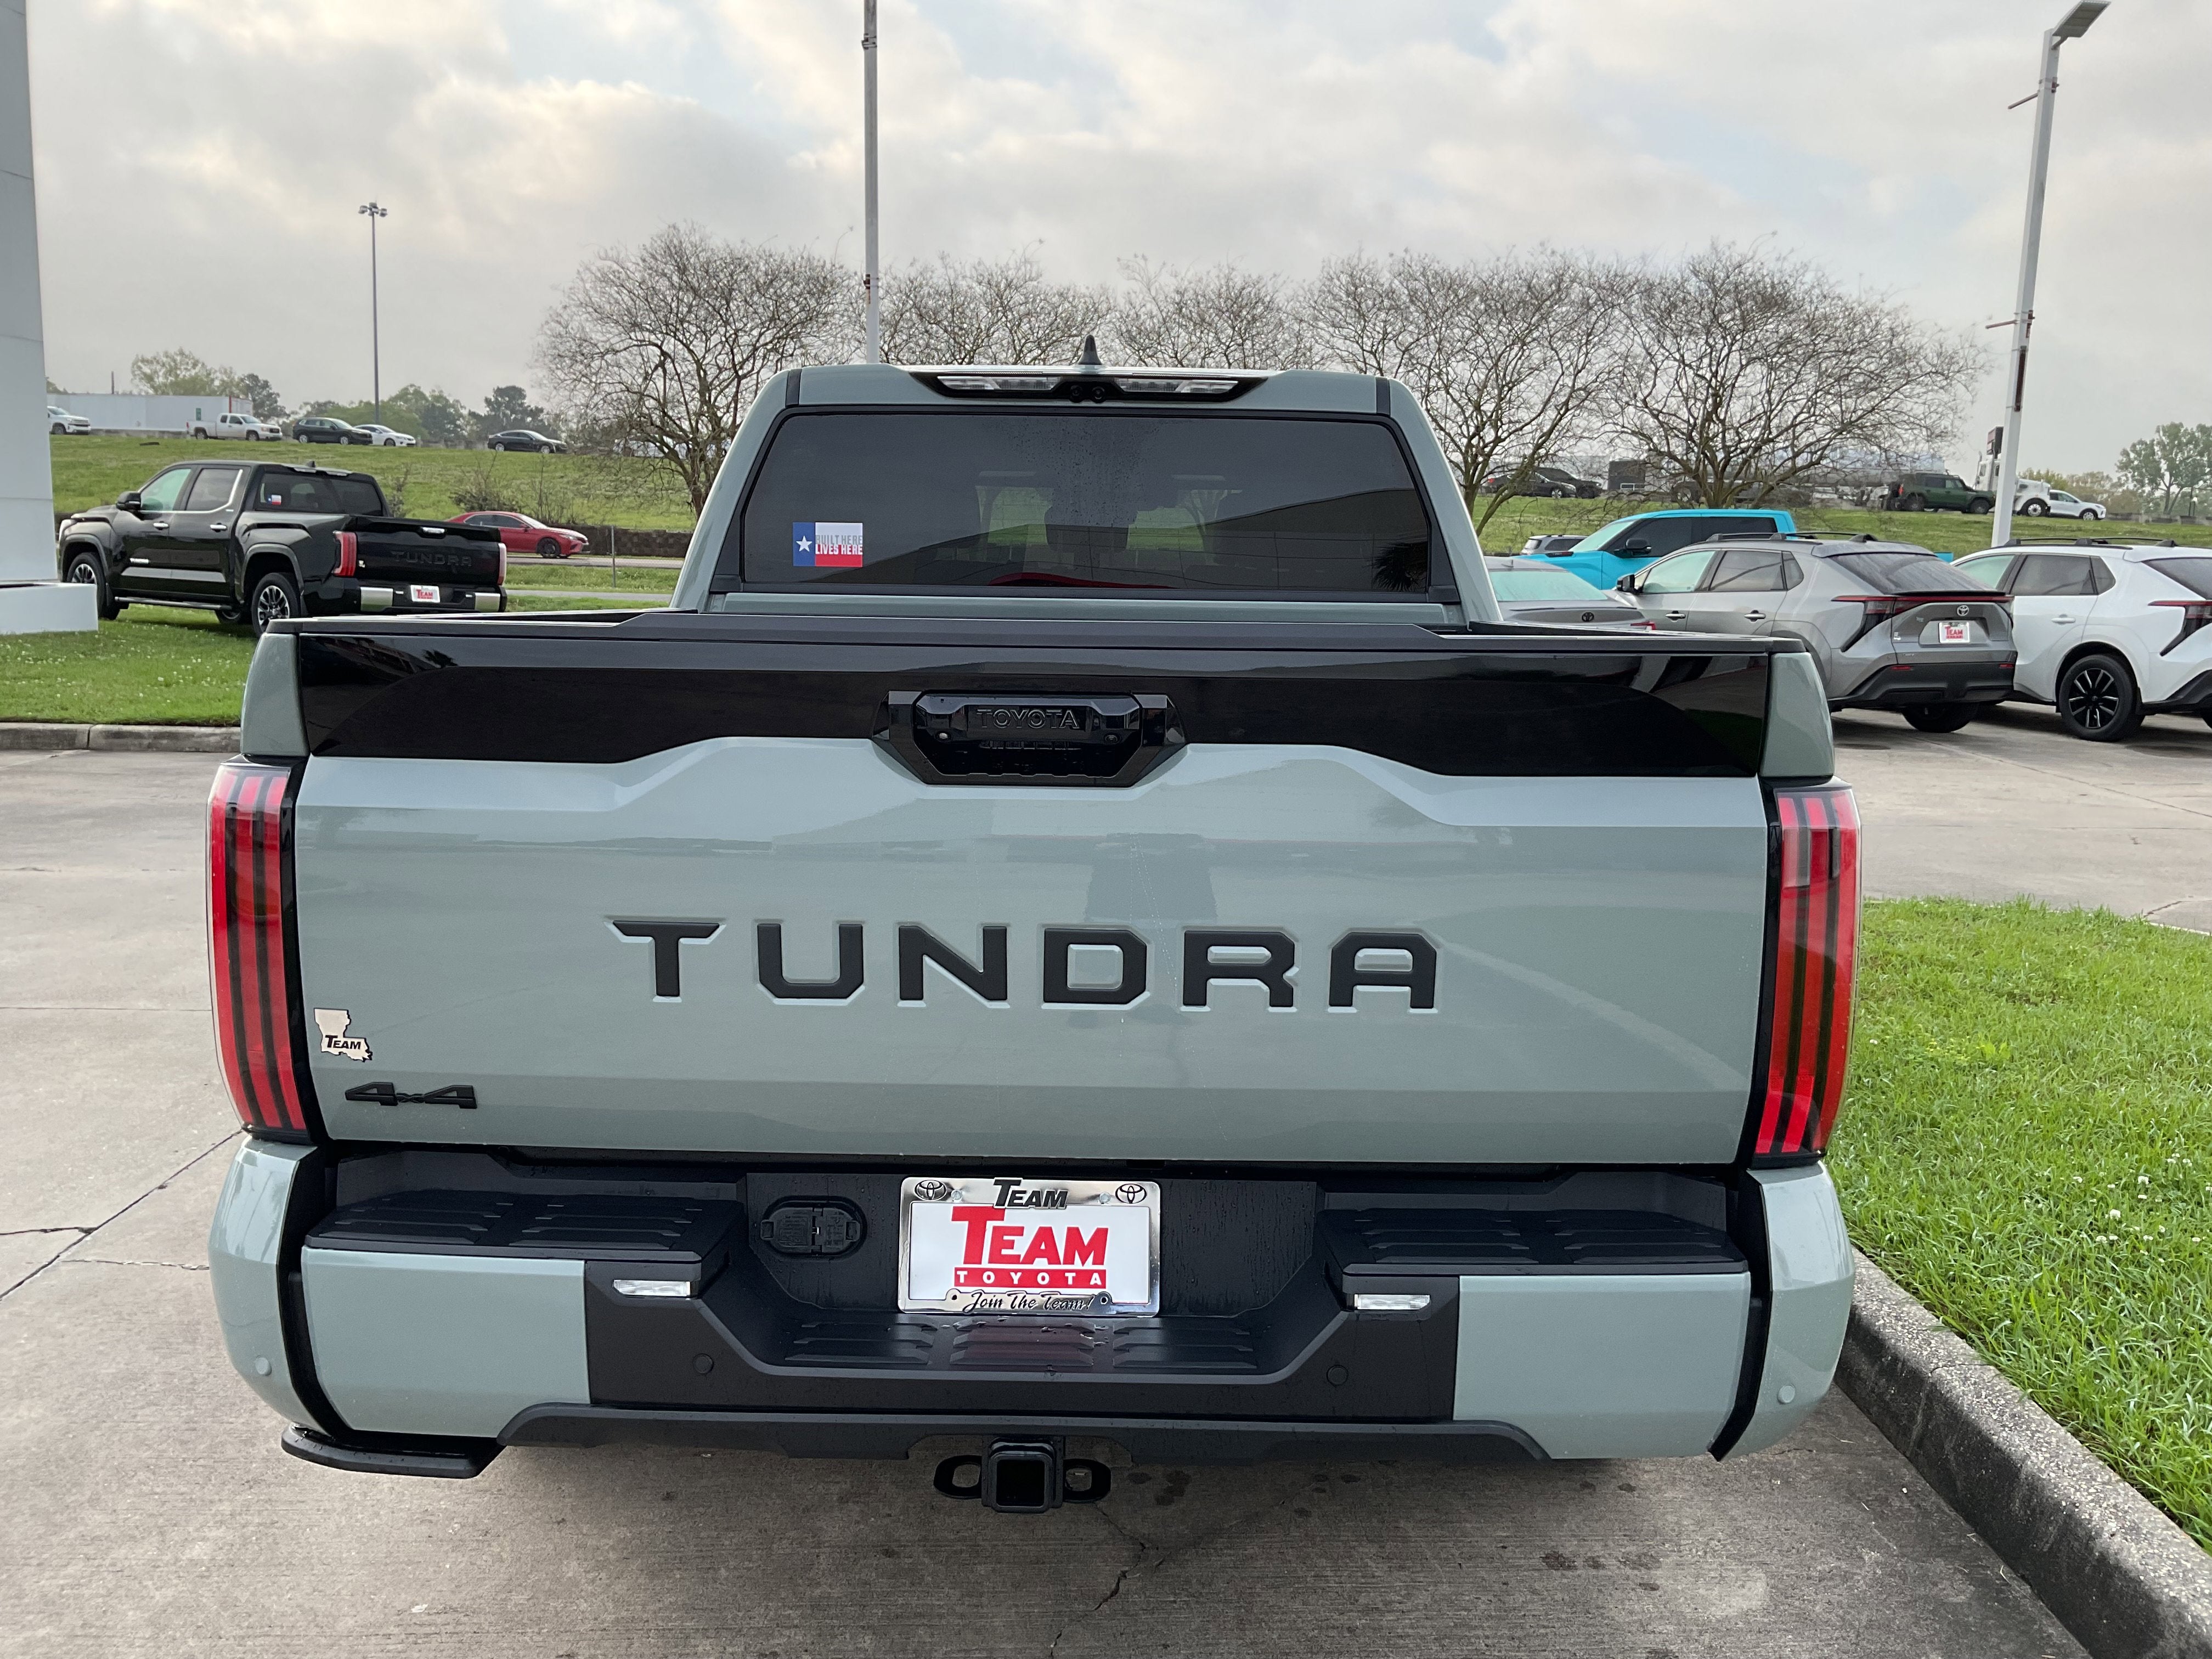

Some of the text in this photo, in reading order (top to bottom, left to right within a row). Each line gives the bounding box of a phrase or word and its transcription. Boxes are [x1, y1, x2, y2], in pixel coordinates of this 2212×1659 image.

[816, 535, 862, 545] BUILT HERE
[815, 544, 862, 555] LIVES HERE
[391, 551, 472, 567] TUNDRA
[977, 708, 1080, 729] TOYOTA
[608, 919, 1438, 1013] TUNDRA
[325, 1035, 362, 1050] TEAM
[993, 1178, 1069, 1209] TEAM
[951, 1206, 1109, 1266] TEAM
[956, 1270, 1103, 1285] TOYOTA
[962, 1291, 1094, 1314] Join The Team!
